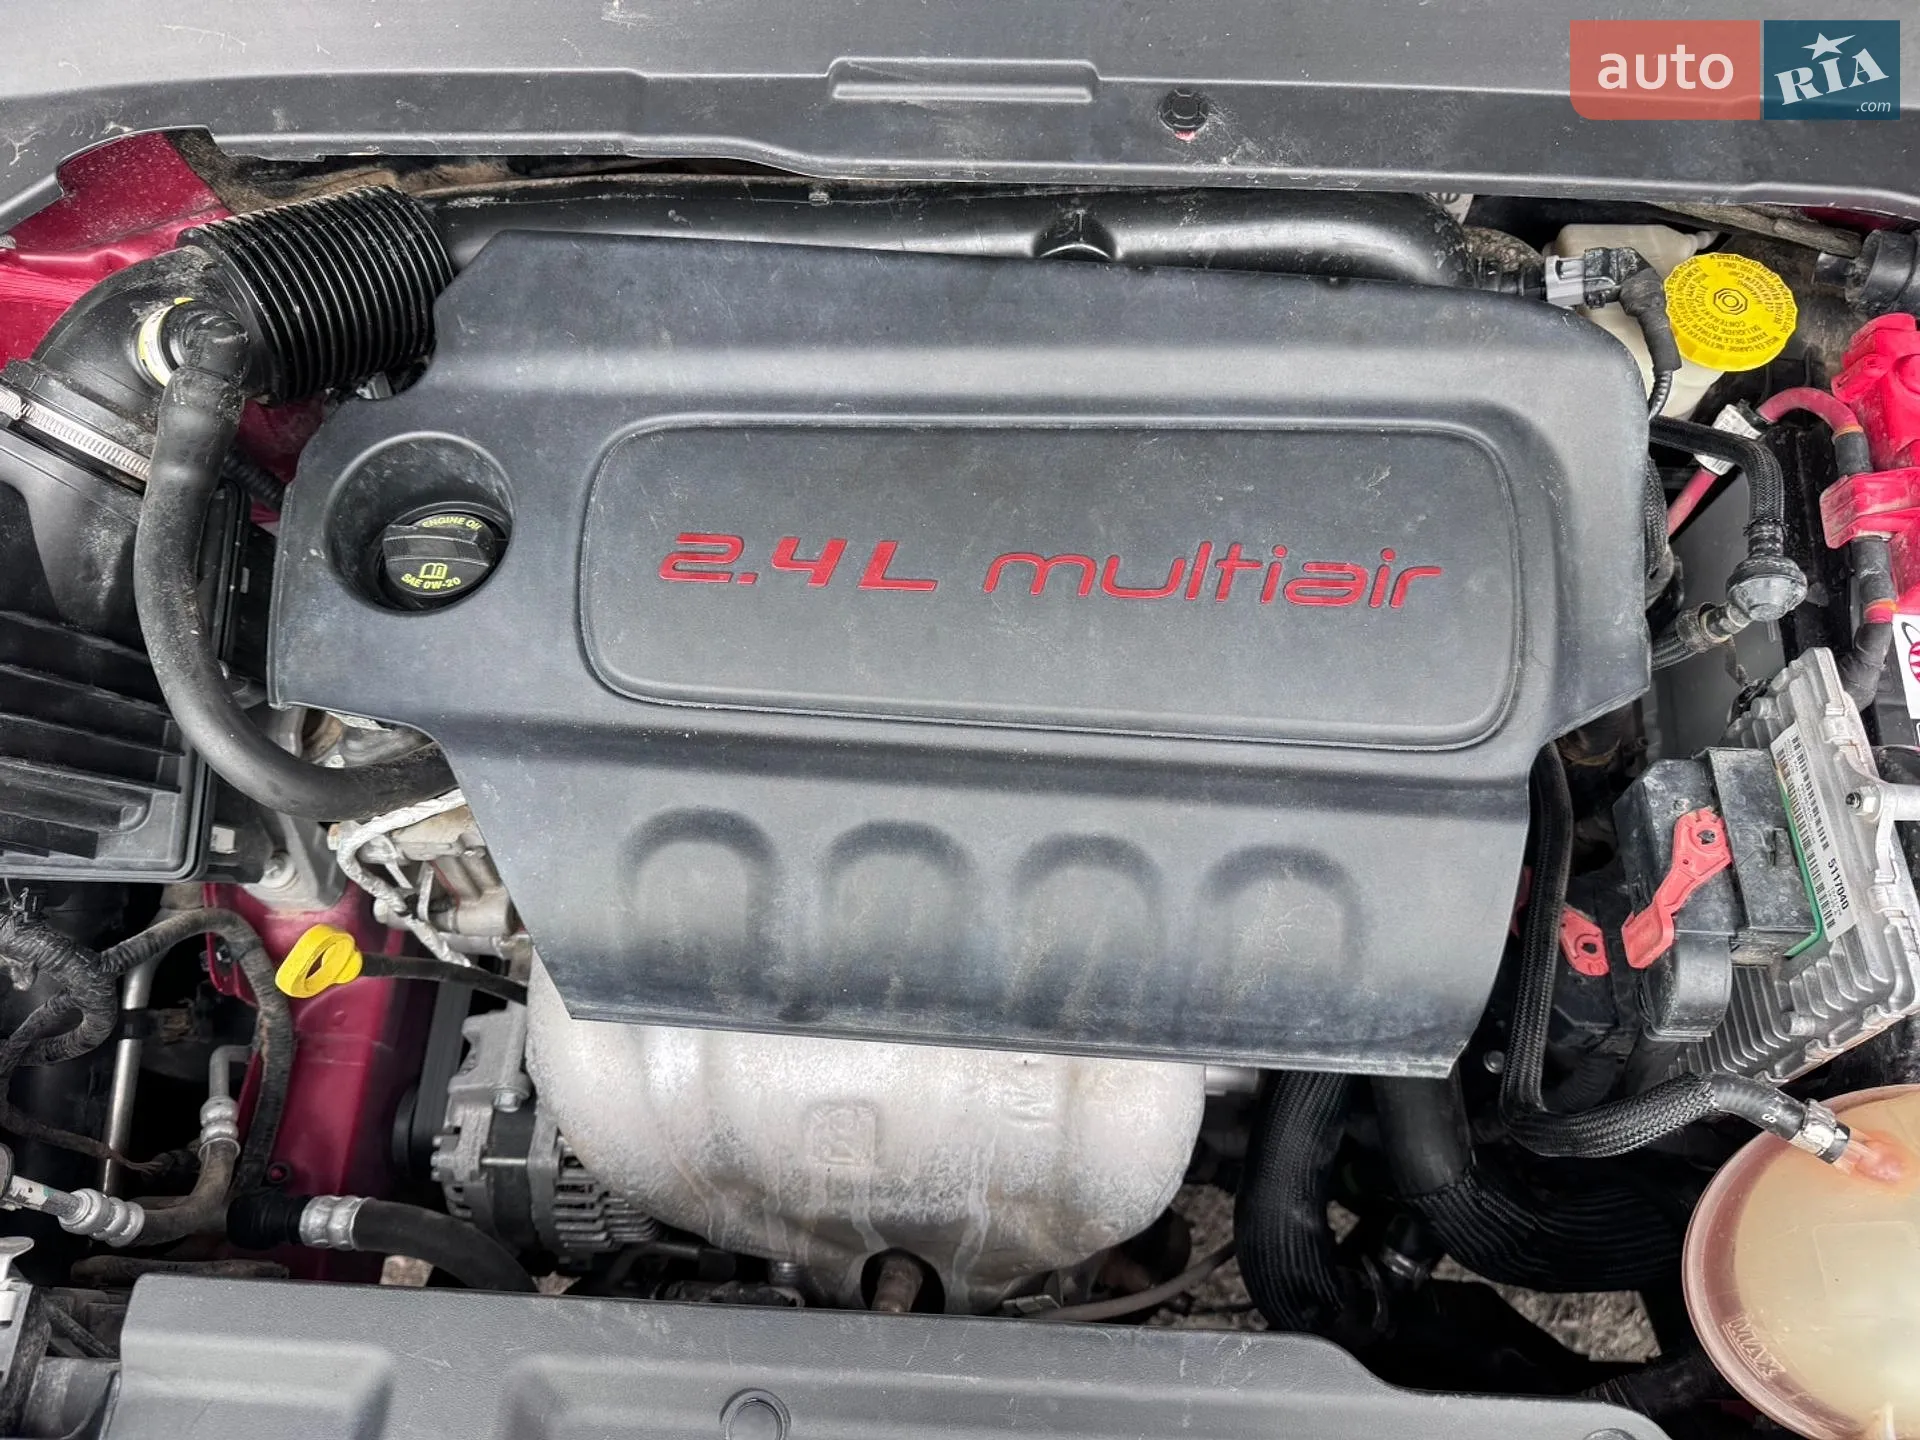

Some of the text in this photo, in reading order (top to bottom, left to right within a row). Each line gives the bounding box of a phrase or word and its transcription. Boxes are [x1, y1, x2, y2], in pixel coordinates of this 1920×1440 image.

[422, 516, 466, 528] ENGINE
[401, 573, 423, 588] SAE
[983, 540, 1442, 608] multiair
[1827, 858, 1850, 911] 5117040
[1728, 1316, 1787, 1379] MAX
